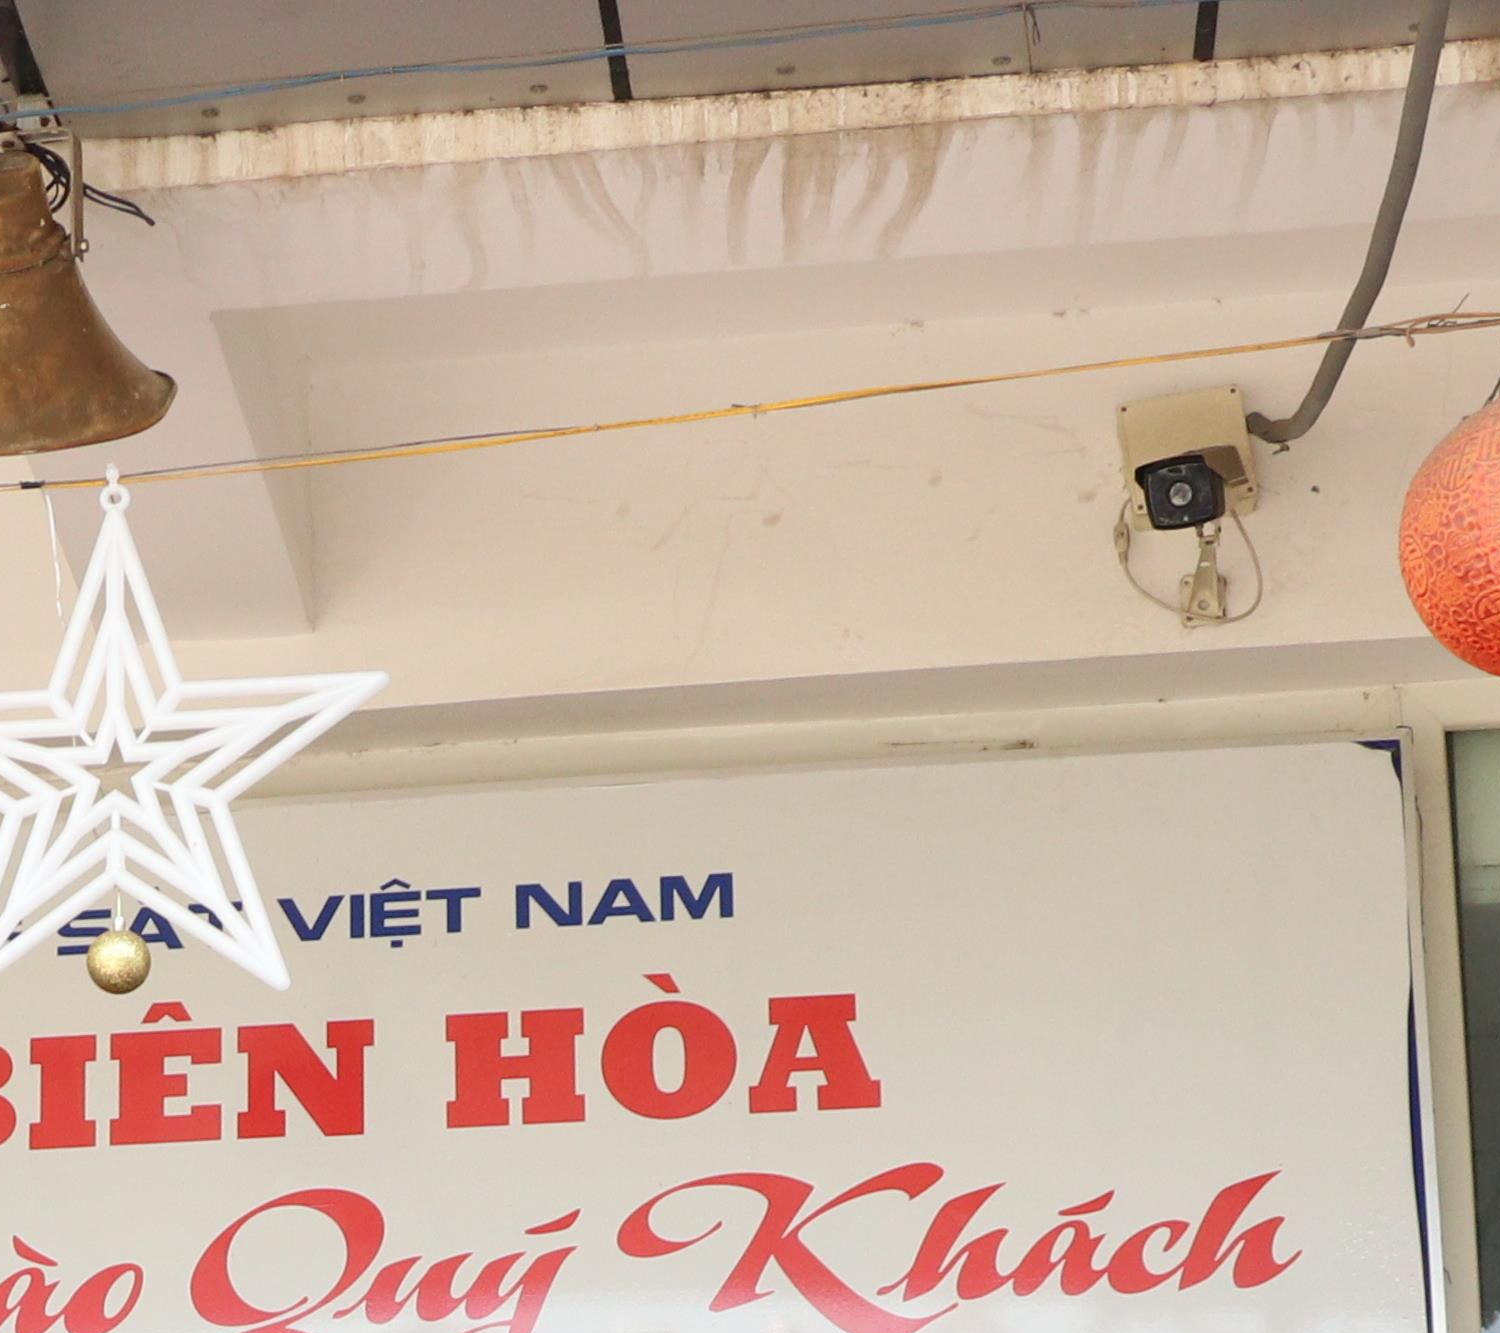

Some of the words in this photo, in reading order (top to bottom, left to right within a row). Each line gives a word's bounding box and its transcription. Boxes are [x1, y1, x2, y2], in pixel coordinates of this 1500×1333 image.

[277, 880, 481, 949] VIỆT
[512, 872, 736, 929] NAM
[441, 972, 882, 1128] HÒA
